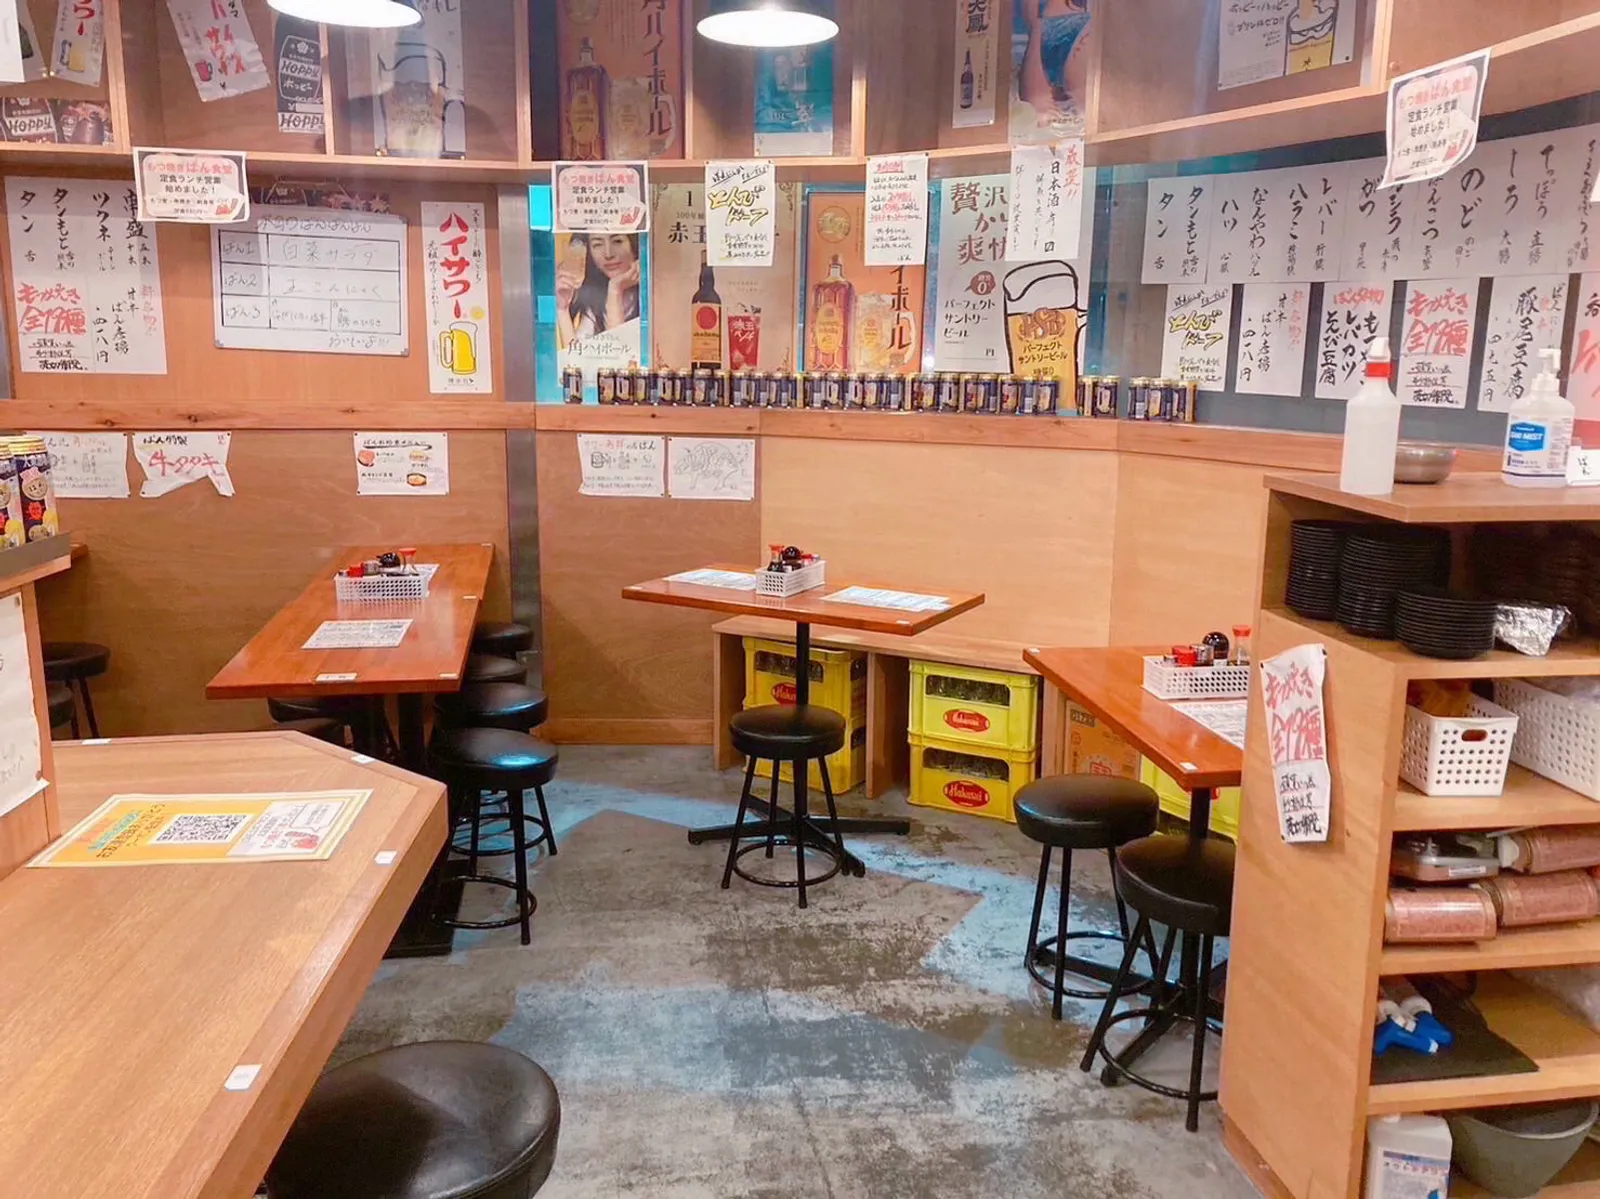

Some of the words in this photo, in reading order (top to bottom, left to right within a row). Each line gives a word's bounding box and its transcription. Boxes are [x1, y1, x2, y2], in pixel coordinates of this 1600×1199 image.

[1157, 192, 1174, 238] タン
[1186, 185, 1203, 256] タンもと
[1220, 199, 1239, 233] ハツ
[1289, 182, 1308, 240] ハラミ
[1317, 177, 1337, 235] レバー
[1460, 167, 1486, 229] のど
[439, 211, 472, 319] ハイサワー
[944, 299, 996, 310] パーフェクト
[944, 313, 989, 325] サントリー
[943, 327, 970, 339] ビール
[1022, 342, 1063, 354] パーフェクト
